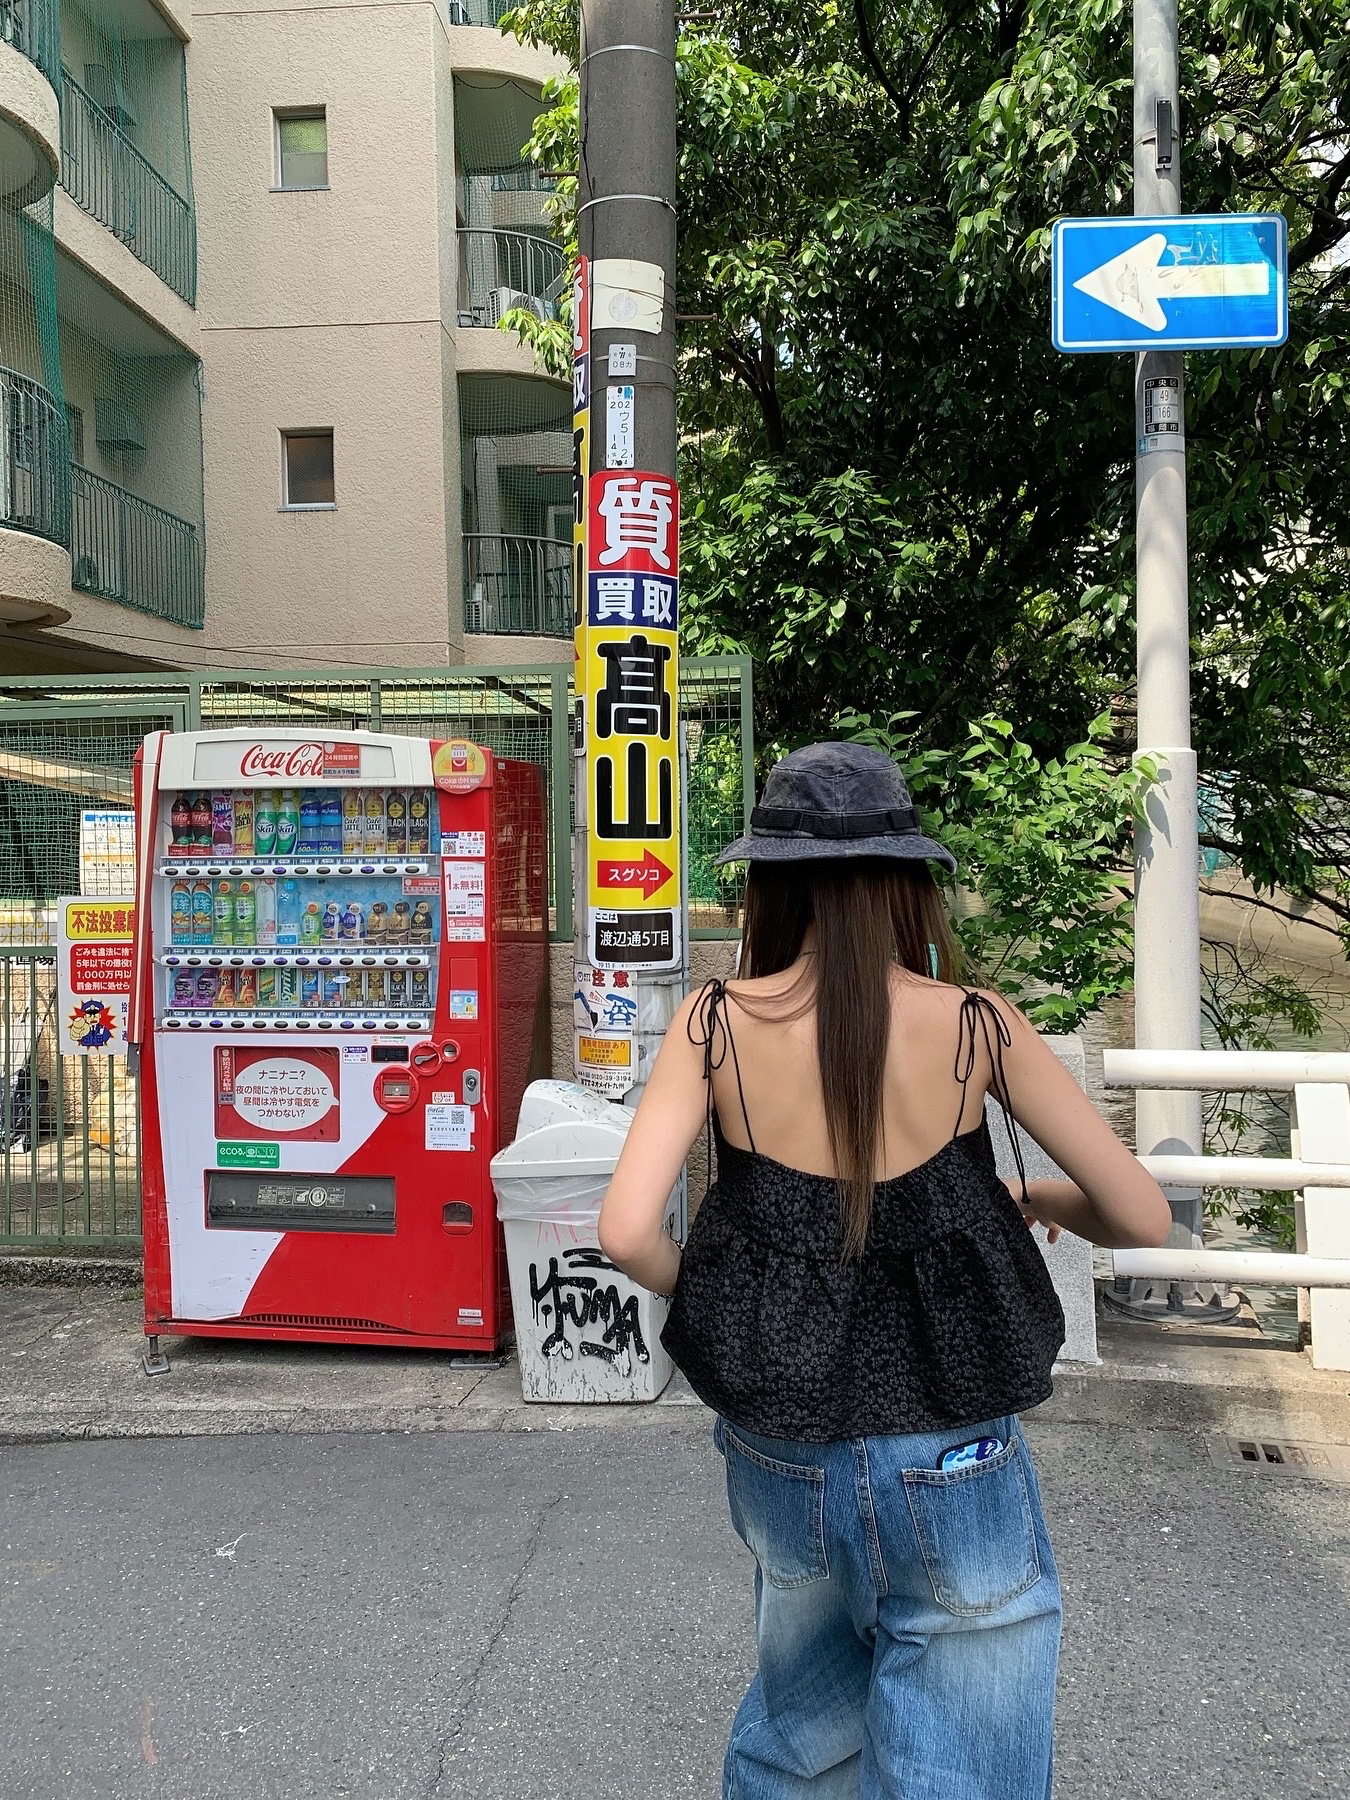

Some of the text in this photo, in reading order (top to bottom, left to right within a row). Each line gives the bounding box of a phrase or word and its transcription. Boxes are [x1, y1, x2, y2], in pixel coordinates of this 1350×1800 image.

[1146, 379, 1177, 387] 中央区
[1160, 389, 1169, 401] 49
[610, 401, 630, 409] 202
[1159, 406, 1171, 418] 166
[598, 477, 673, 570] 質
[596, 577, 673, 625] 買取
[608, 868, 660, 881] スグソコ
[446, 874, 483, 890] 1本無料!
[595, 913, 616, 921] ここは
[600, 930, 669, 947] 渡辺通5丁目
[592, 969, 629, 988] 注意
[259, 1070, 306, 1080] ナニナニ?
[236, 1085, 328, 1095] 夜の間に冷やしておいて
[243, 1097, 320, 1107] 昼間は冷やす電気を
[257, 1109, 305, 1118] つかわない?
